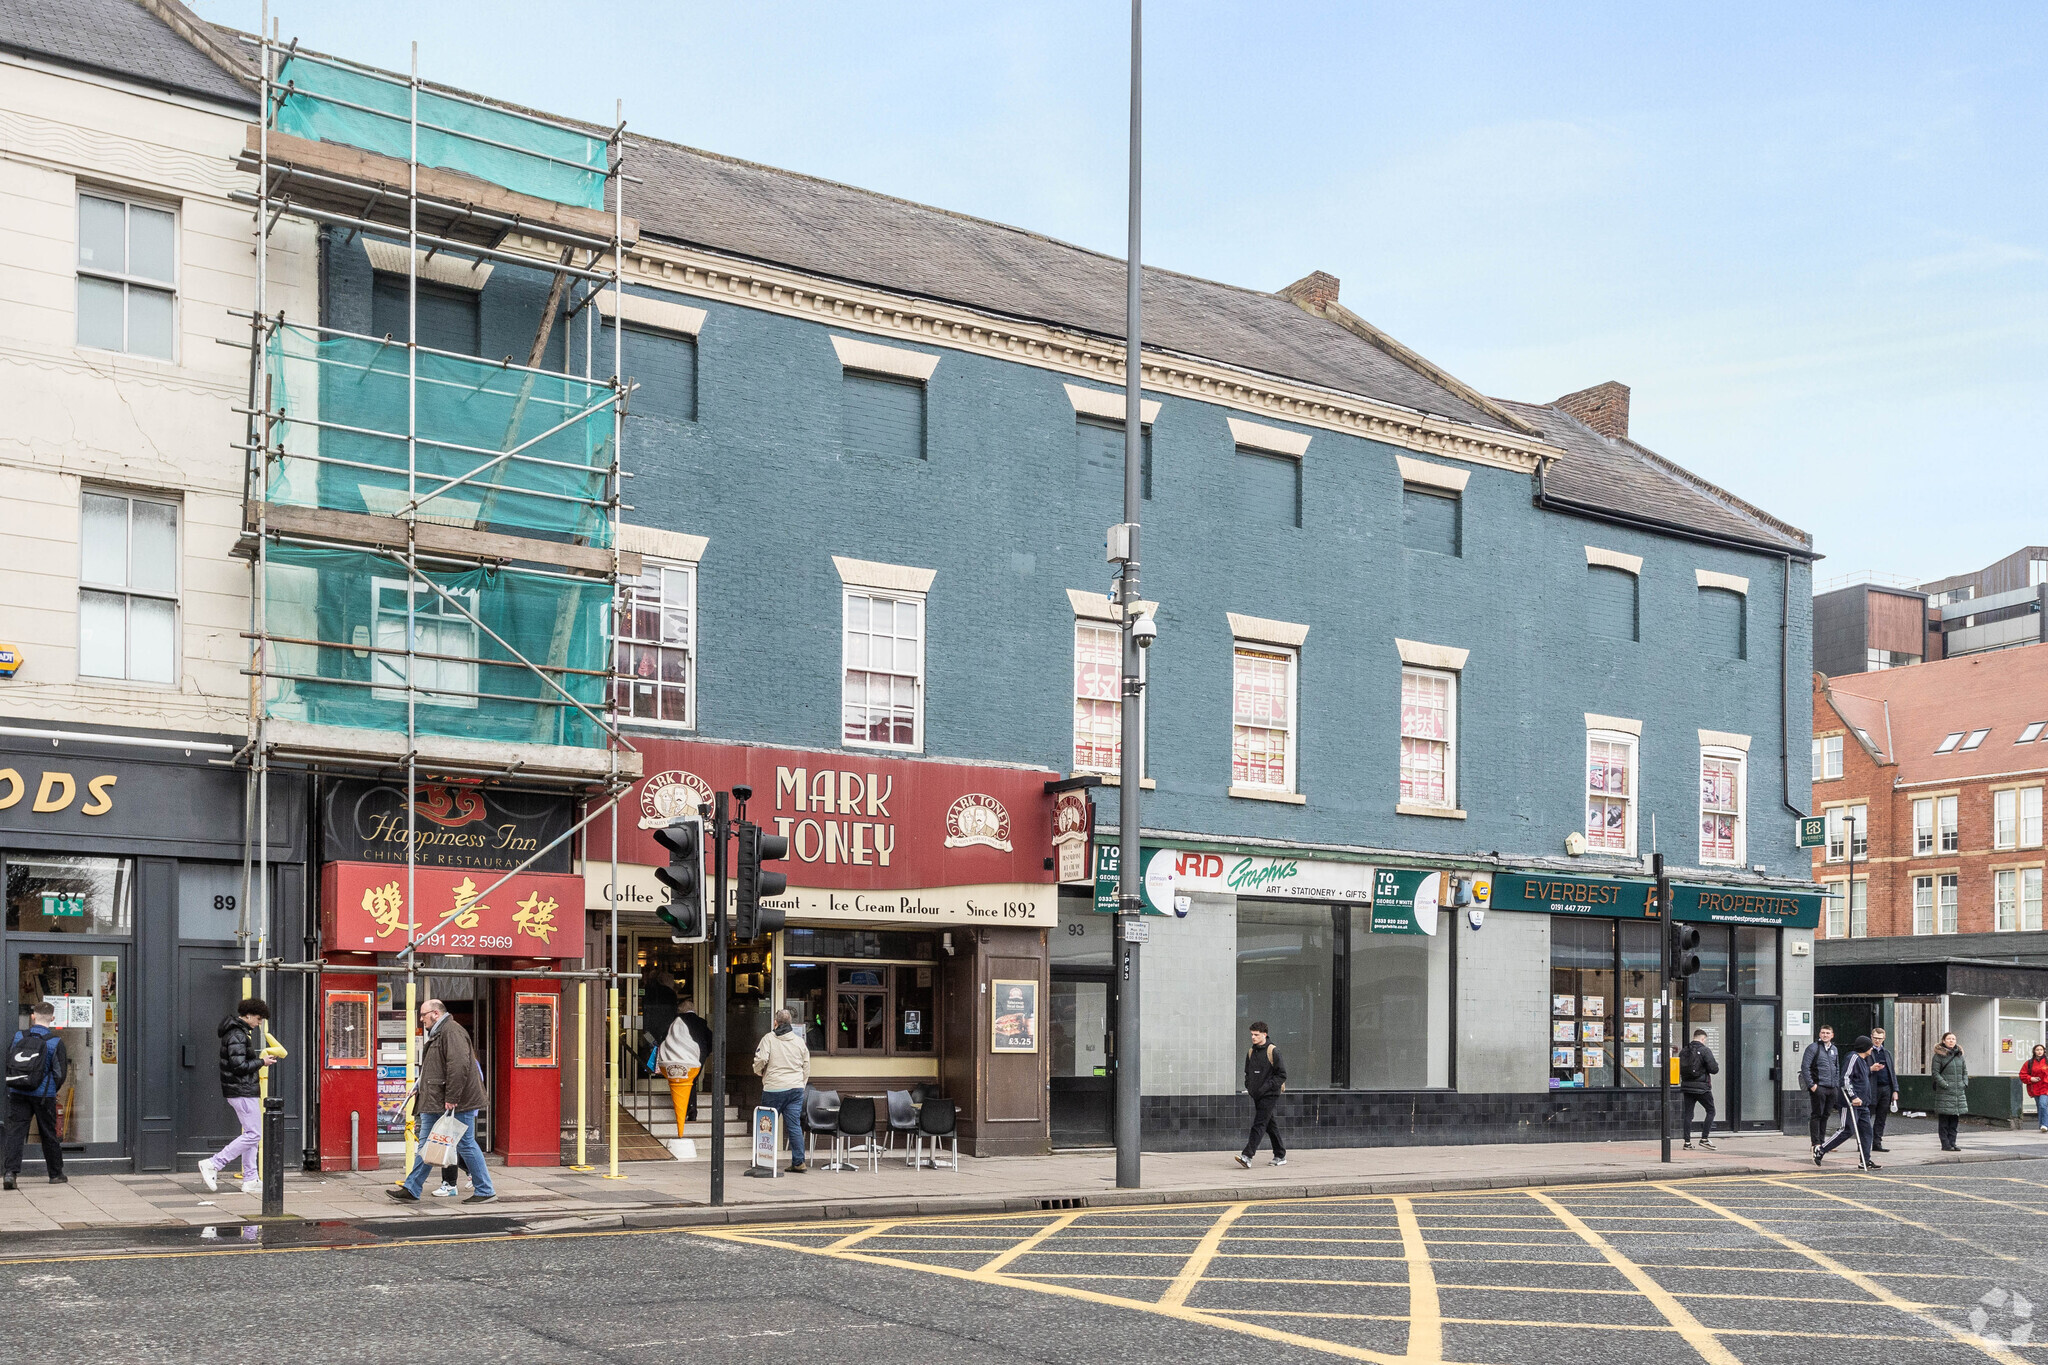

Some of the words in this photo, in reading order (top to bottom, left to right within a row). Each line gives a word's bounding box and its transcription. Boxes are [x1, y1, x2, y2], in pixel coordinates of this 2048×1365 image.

[642, 772, 676, 805] MARK
[776, 766, 893, 818] MARK
[948, 795, 977, 825] MARK
[978, 794, 1009, 829] TONEY
[361, 814, 486, 852] Happiness
[492, 823, 538, 851] Inn
[773, 816, 895, 867] TONEY
[363, 850, 430, 864] CHINESE
[1102, 846, 1119, 857] TO
[1227, 857, 1298, 892] Graphics
[1379, 872, 1394, 884] TO
[603, 884, 654, 903] Coffee
[1265, 885, 1282, 894] ART
[1290, 886, 1336, 897] STATIONERY
[1345, 889, 1367, 899] GIFTS
[1377, 884, 1399, 896] LET
[1524, 880, 1622, 905] EVERBEST
[1698, 892, 1800, 916] PROPERTIES
[213, 895, 237, 911] 89
[730, 889, 800, 909] Raurant
[830, 893, 849, 911] Ice
[855, 894, 895, 913] Cream
[900, 896, 940, 915] Parlour
[966, 899, 998, 918] Since
[1003, 901, 1036, 919] 1892
[1550, 903, 1564, 911] 0191
[1564, 904, 1577, 912] 447
[1577, 905, 1592, 913] 7277
[1711, 914, 1783, 925] www.everbestproperties.co.uk
[1068, 923, 1085, 937] 93
[416, 933, 446, 947] 0191
[450, 934, 476, 948] 232
[479, 935, 513, 949] 5969
[1008, 1037, 1031, 1046] £3.25
[377, 1085, 406, 1093] FUNFA
